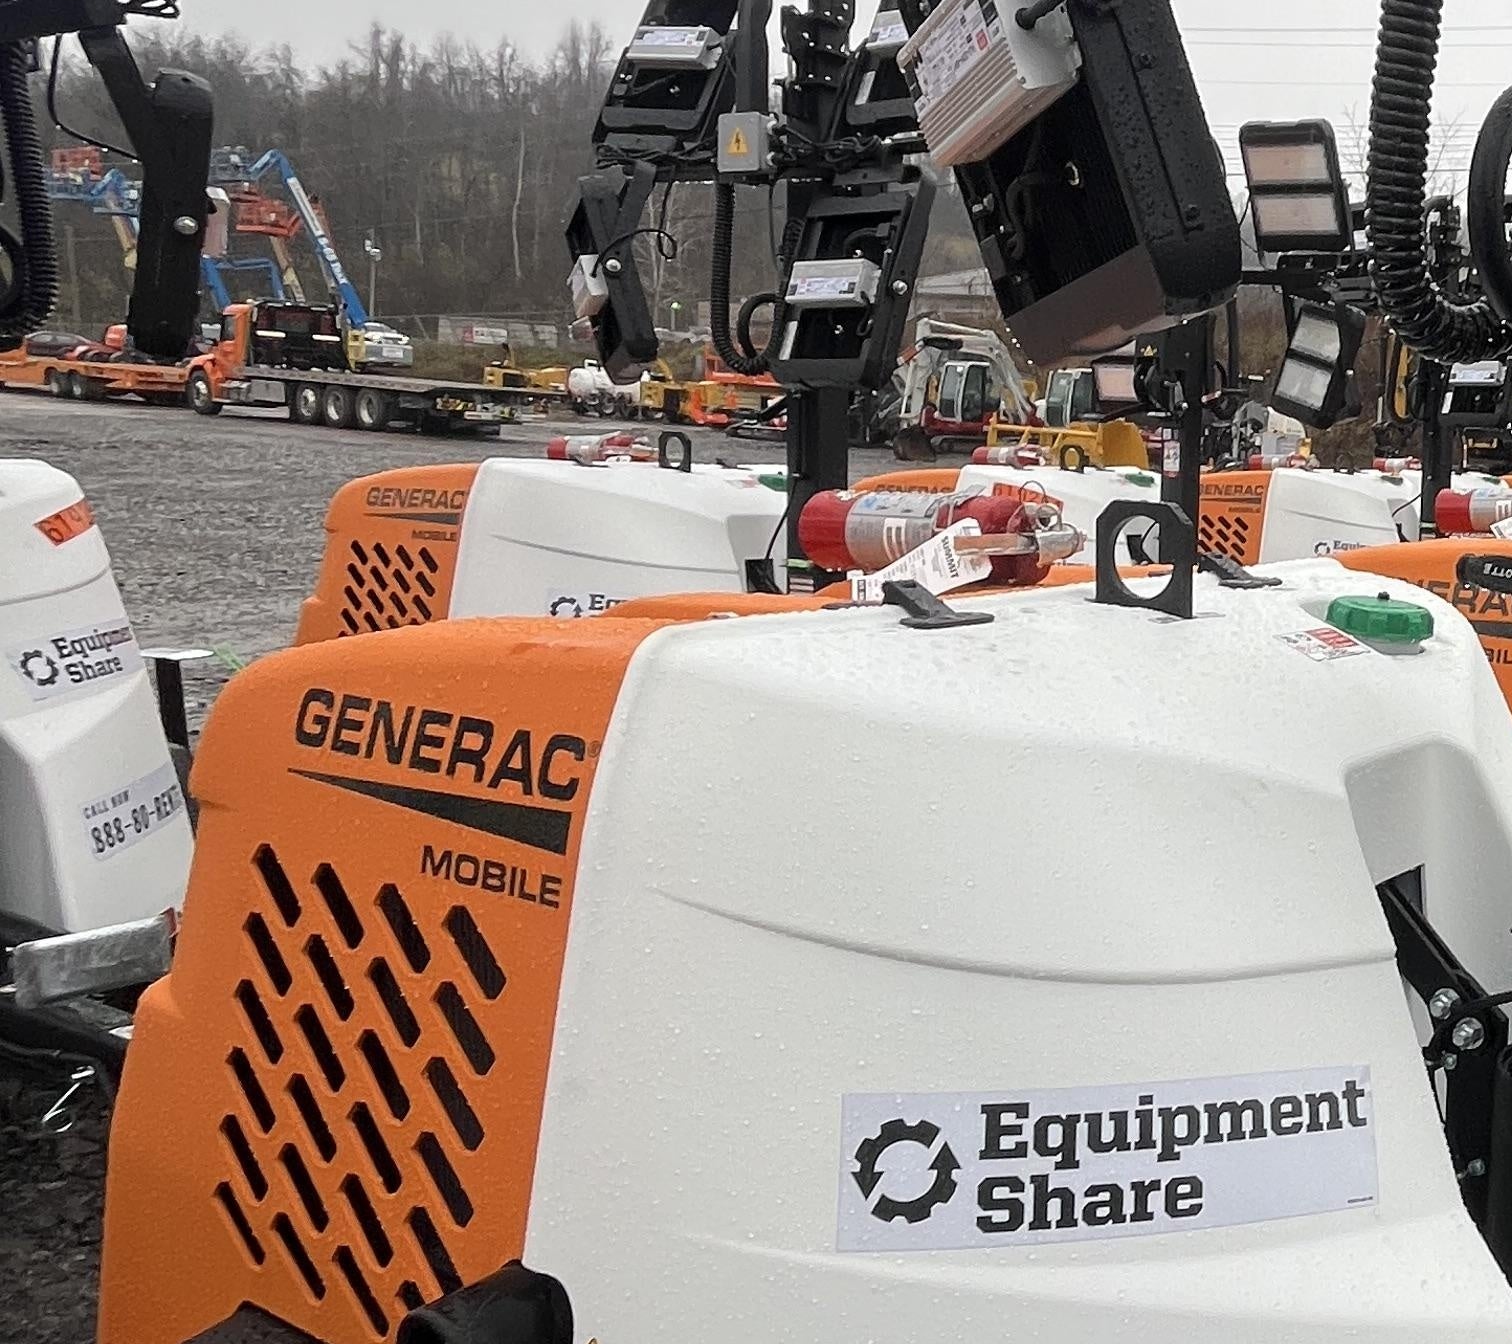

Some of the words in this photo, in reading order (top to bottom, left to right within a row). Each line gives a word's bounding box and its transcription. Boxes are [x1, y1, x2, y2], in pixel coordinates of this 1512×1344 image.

[366, 486, 465, 510] GENERAC
[65, 656, 124, 684] Share
[295, 688, 586, 801] GENERAC
[420, 845, 562, 909] MOBILE
[978, 1080, 1369, 1170] Equipment
[974, 1173, 1205, 1234] Share
